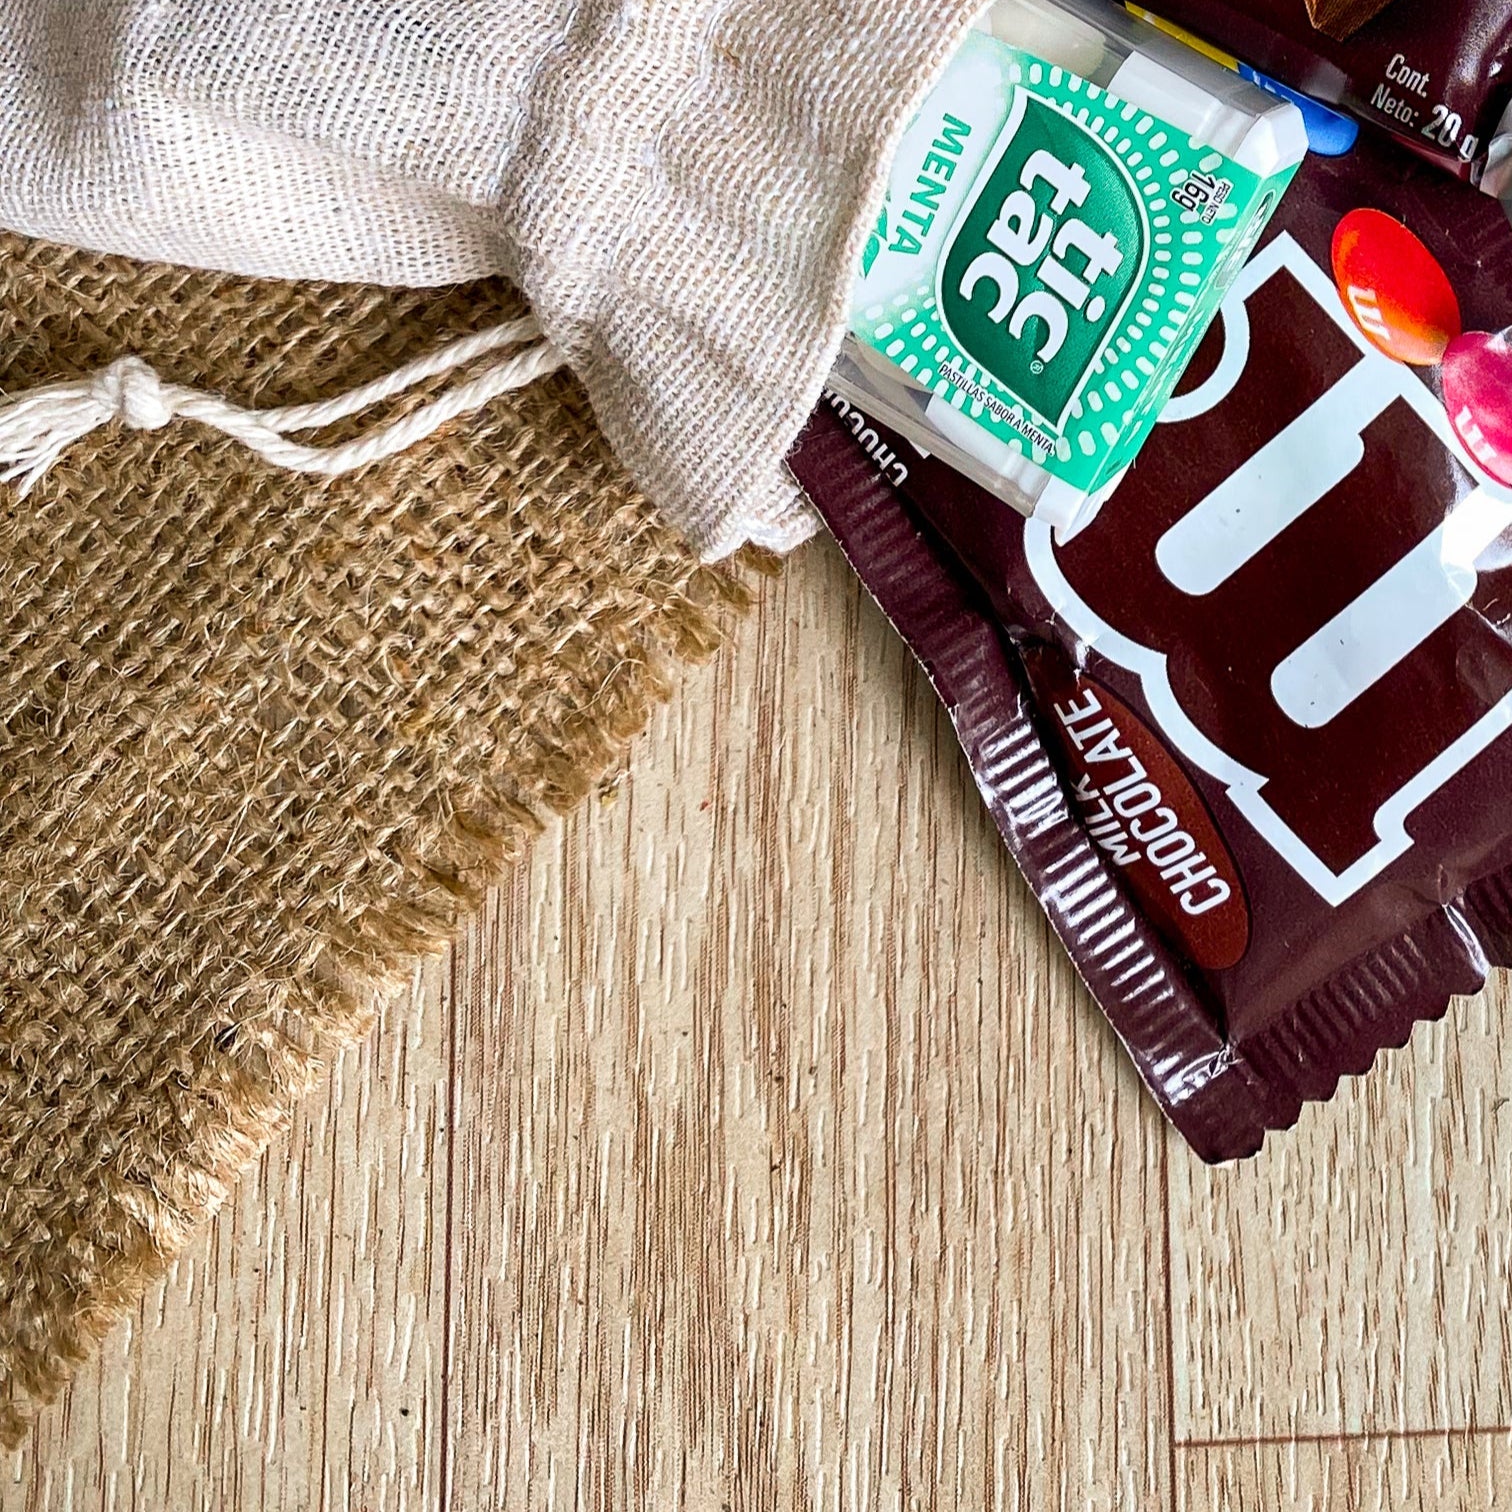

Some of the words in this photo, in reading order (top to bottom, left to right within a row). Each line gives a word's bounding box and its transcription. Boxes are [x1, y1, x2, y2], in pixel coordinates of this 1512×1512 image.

[1370, 82, 1420, 128] Neto:
[1421, 103, 1463, 148] 20
[1384, 52, 1430, 99] Cont.
[886, 111, 972, 256] MENTA
[1171, 172, 1215, 213] 16g
[1212, 180, 1231, 204] PESO
[958, 148, 1093, 327] tac
[1007, 221, 1125, 365] tic
[939, 363, 986, 403] PASTILLAS
[983, 396, 1016, 425] SABOR
[1012, 418, 1023, 431] A
[1053, 687, 1231, 916] CHOCOLATE
[1070, 772, 1142, 867] MILK
